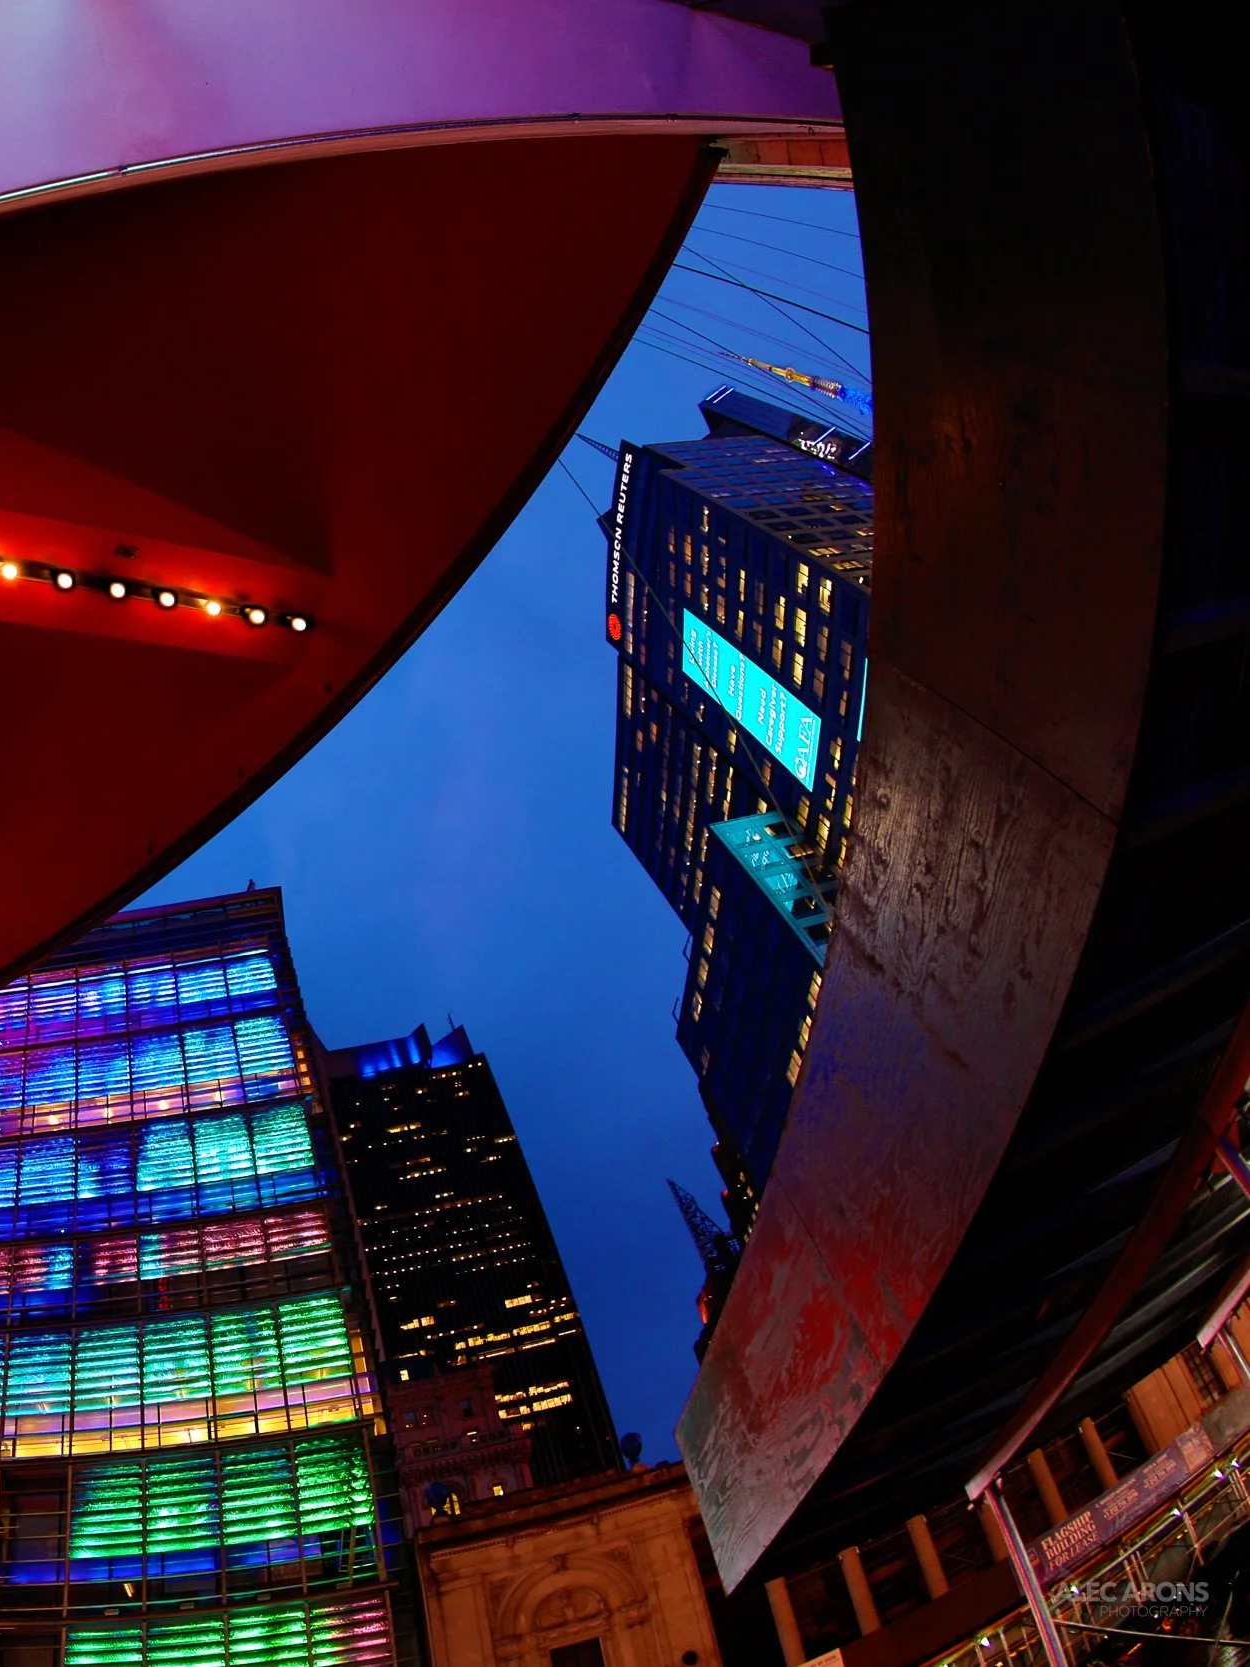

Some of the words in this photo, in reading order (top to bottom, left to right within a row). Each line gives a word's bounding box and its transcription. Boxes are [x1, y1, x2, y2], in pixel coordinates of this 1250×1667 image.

[616, 453, 632, 525] REUTERS
[611, 527, 623, 603] THOMSON
[728, 664, 737, 697] Have
[735, 653, 746, 721] Questions?
[757, 688, 767, 725] Need
[765, 683, 778, 746] Caregiver
[775, 692, 787, 754] Support?
[1041, 1511, 1092, 1548] FLAGSHIP
[1045, 1521, 1097, 1559] BUILDING
[1049, 1553, 1070, 1571] FOR
[1069, 1532, 1099, 1559] LEASE
